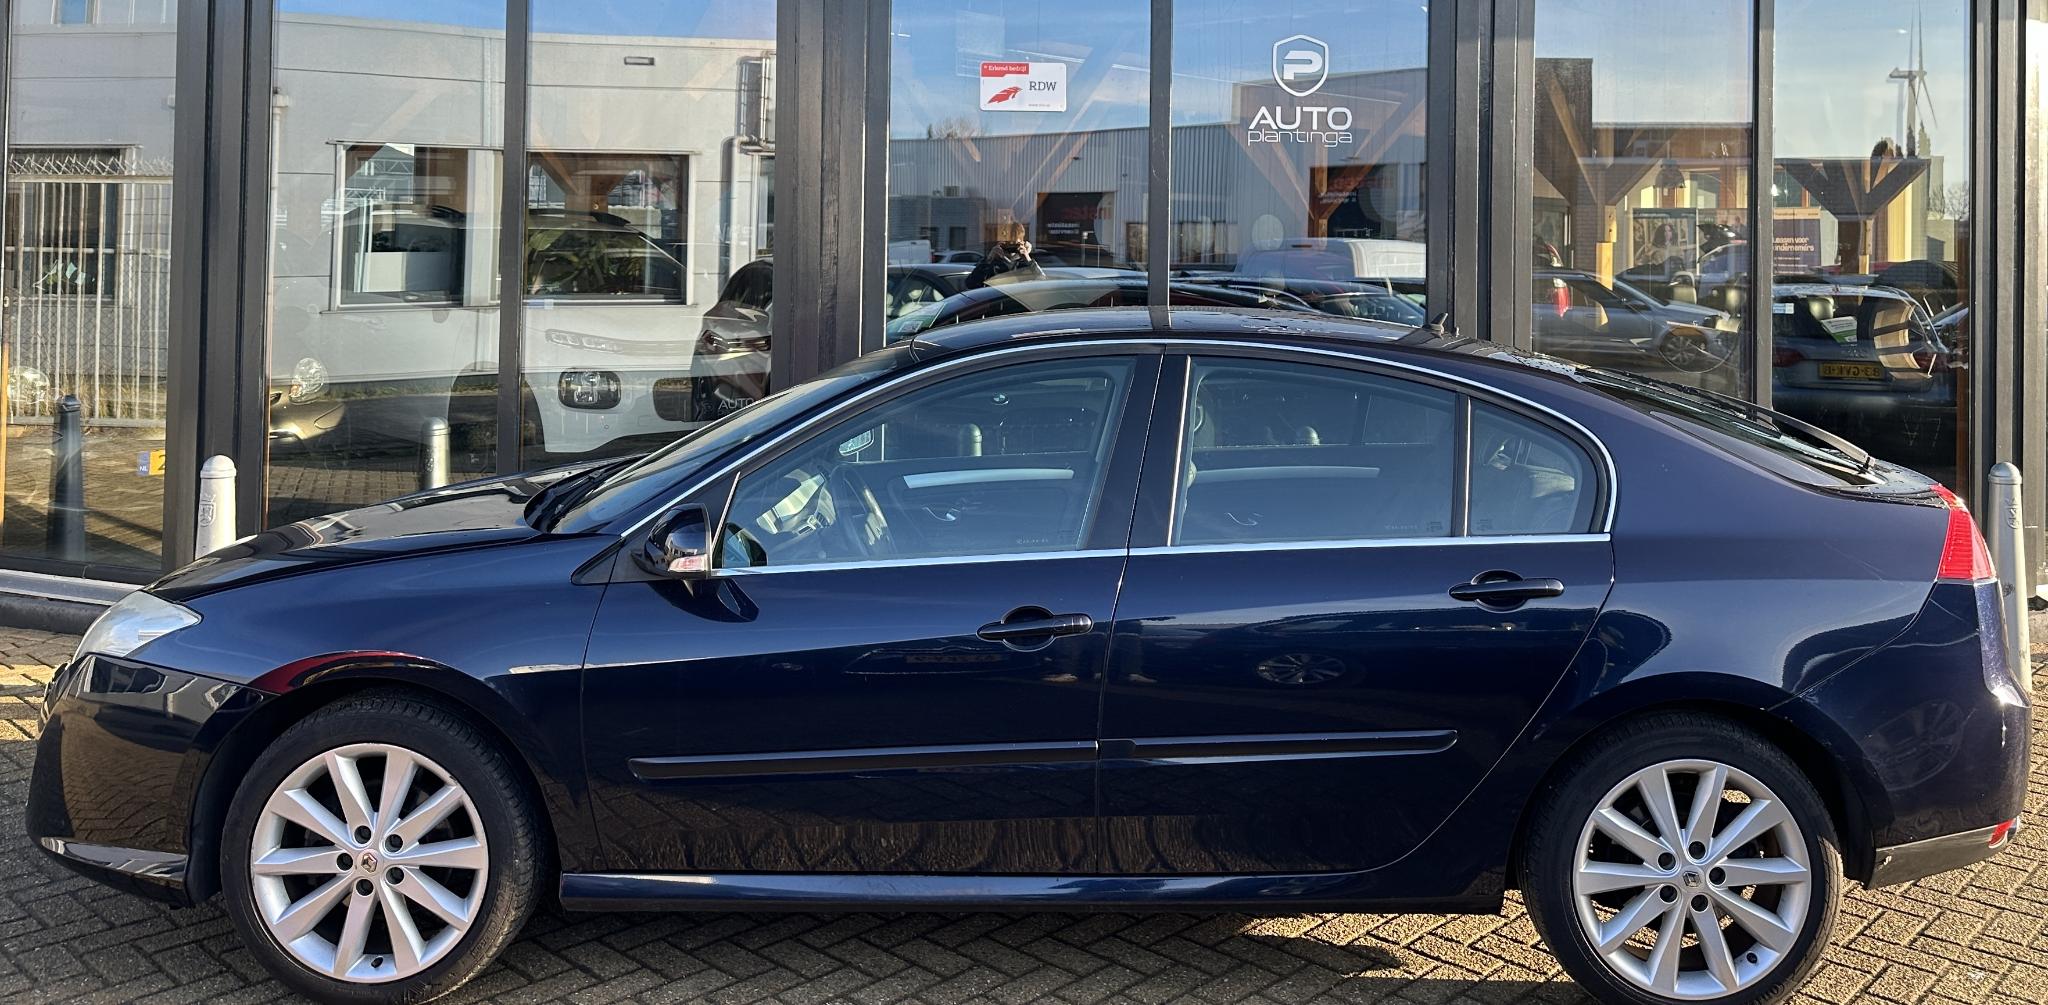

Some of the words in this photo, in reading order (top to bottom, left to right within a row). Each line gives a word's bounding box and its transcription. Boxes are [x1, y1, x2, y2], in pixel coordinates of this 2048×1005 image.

[1283, 50, 1323, 80] P
[1028, 81, 1057, 92] RDW
[1248, 106, 1353, 131] AUTO
[1247, 128, 1353, 148] plantinga
